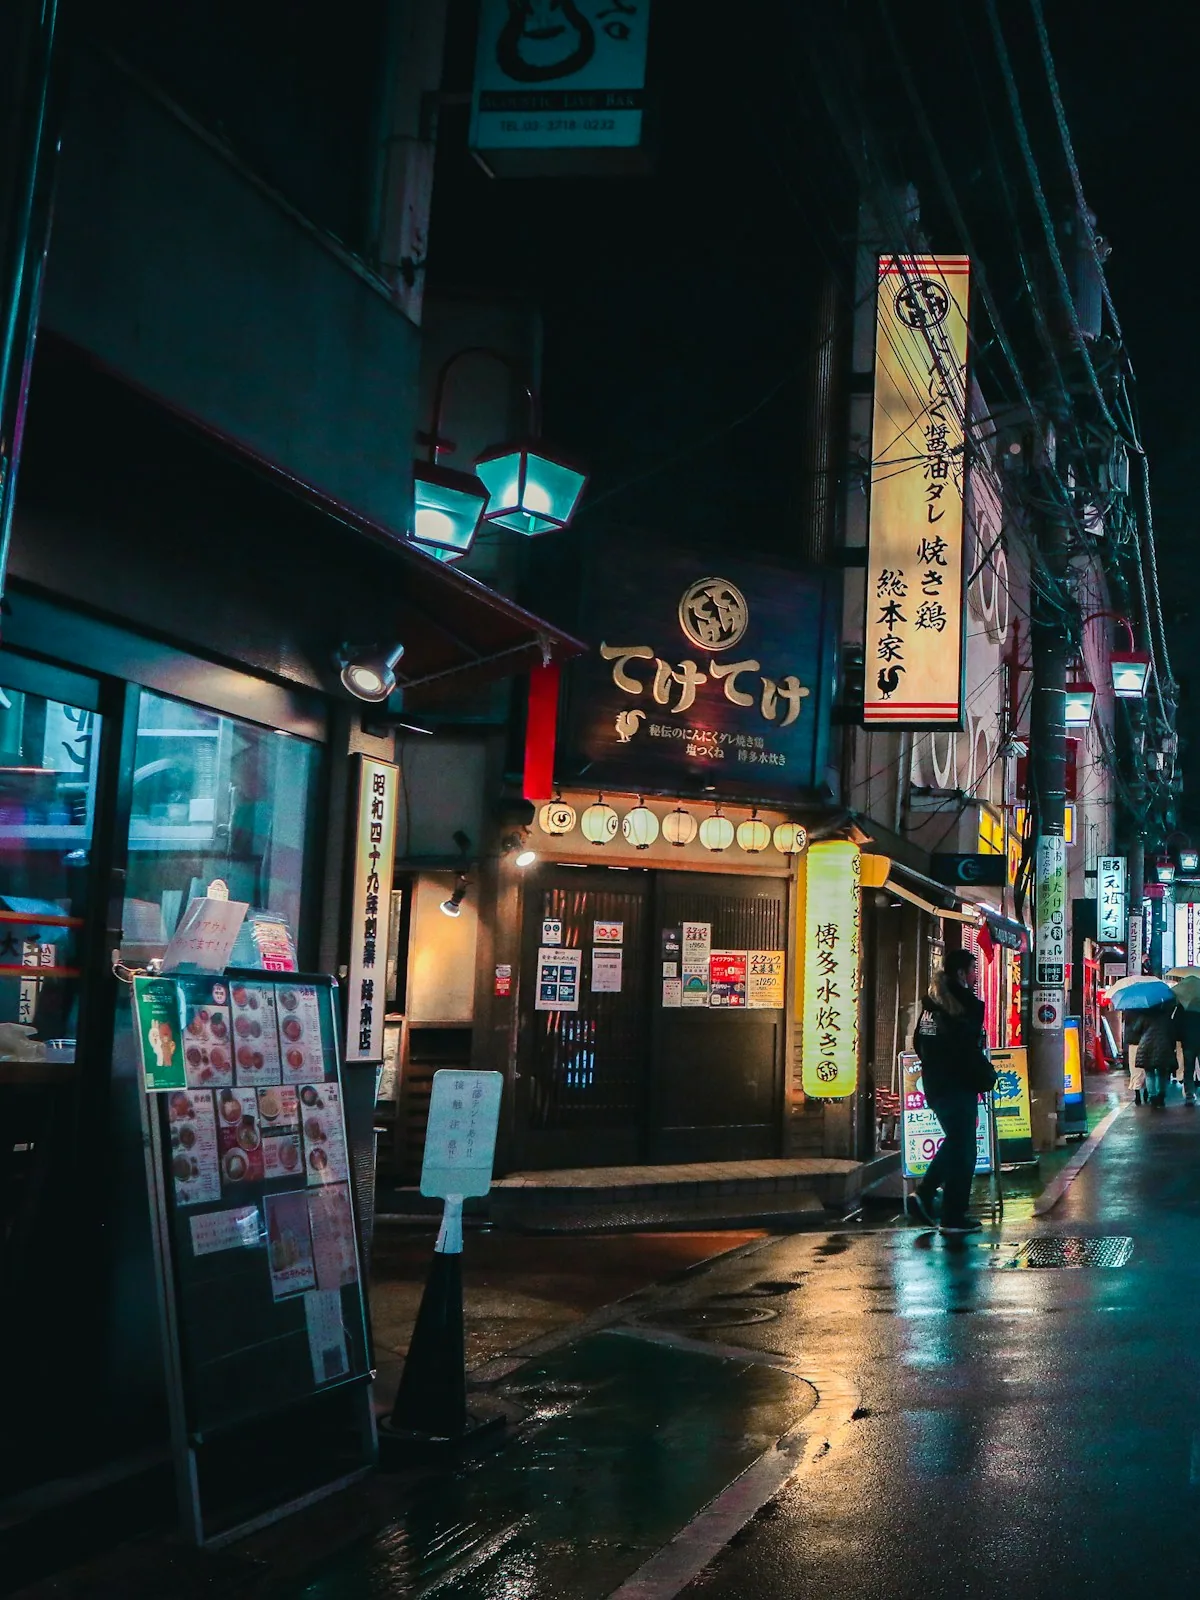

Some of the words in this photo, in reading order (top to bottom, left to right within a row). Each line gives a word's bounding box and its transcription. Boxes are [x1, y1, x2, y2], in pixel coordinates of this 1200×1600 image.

[876, 569, 908, 663] 総本家
[914, 534, 949, 634] 焼き鶏
[600, 641, 810, 727] てけてけ
[648, 723, 764, 749] 秘伝のにんにくダレ焼き鶏
[686, 743, 724, 760] 塩つくね
[737, 751, 787, 767] 博多水炊き
[1051, 850, 1064, 941] おおたけ眼科
[815, 922, 842, 1056] 博多水炊き
